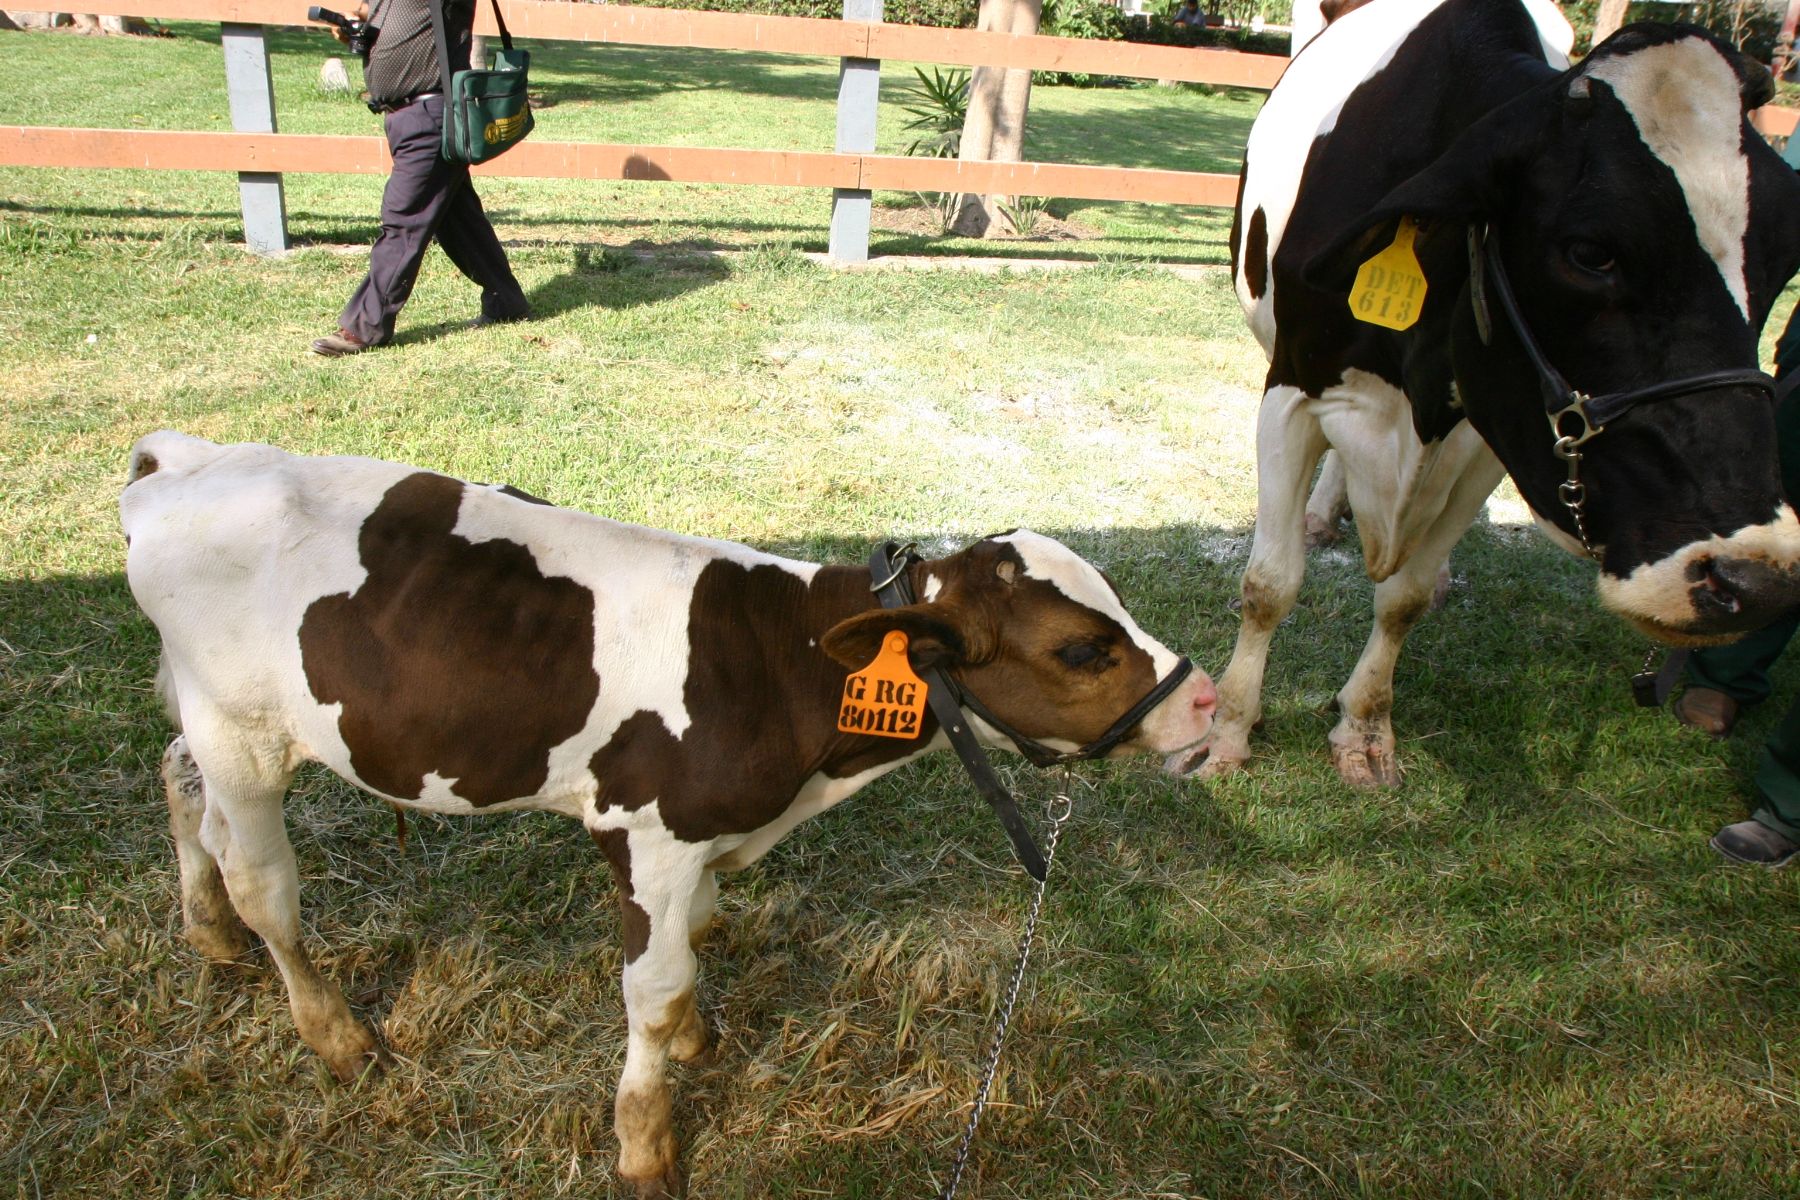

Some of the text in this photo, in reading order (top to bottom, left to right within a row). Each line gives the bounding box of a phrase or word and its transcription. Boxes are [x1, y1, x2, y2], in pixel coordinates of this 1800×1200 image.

[1366, 265, 1422, 299] DET
[1358, 290, 1412, 322] 613
[840, 704, 917, 733] 80112
